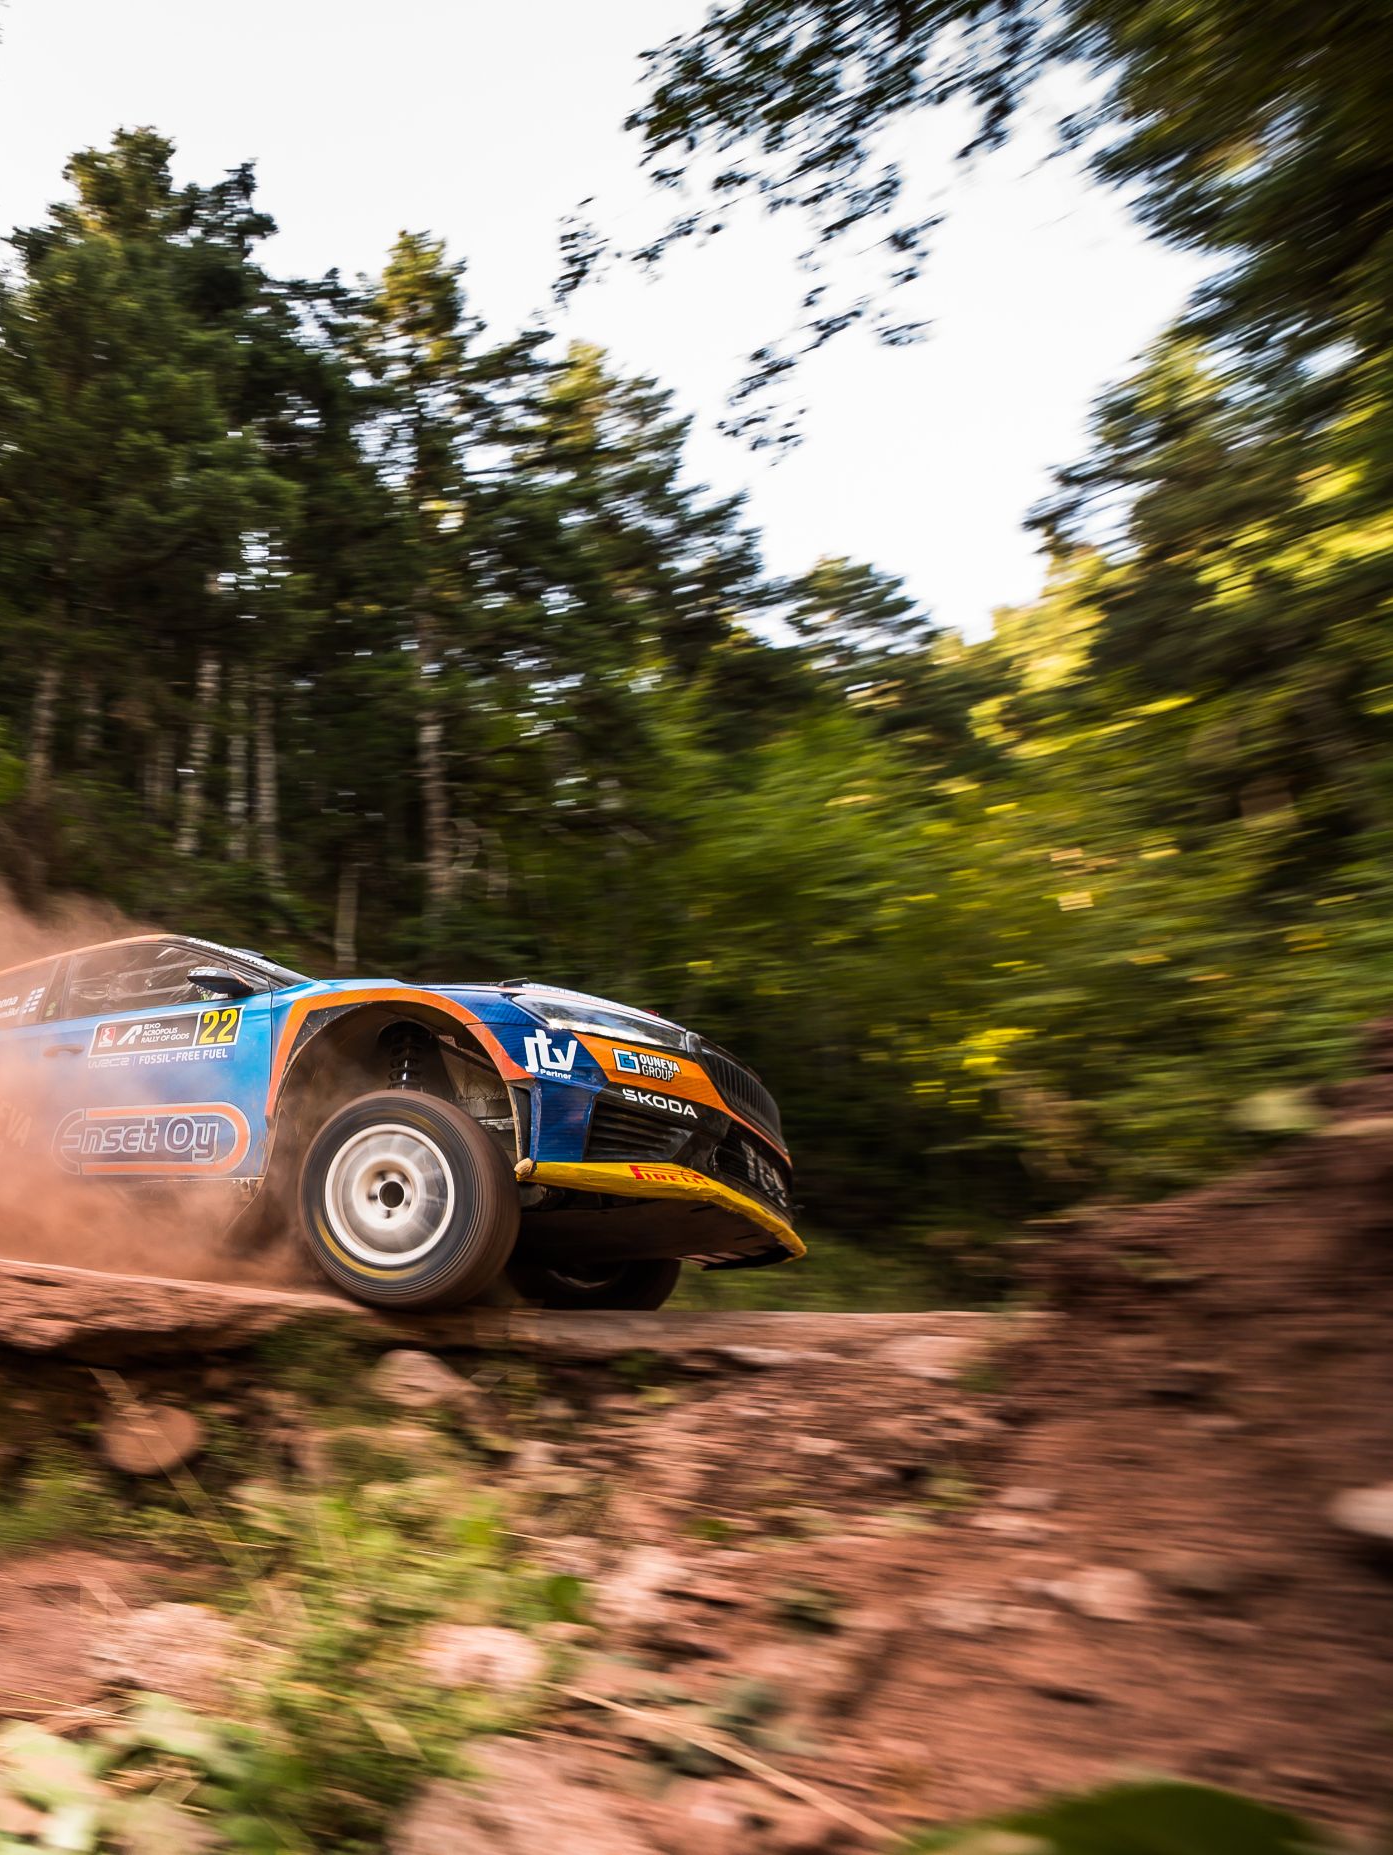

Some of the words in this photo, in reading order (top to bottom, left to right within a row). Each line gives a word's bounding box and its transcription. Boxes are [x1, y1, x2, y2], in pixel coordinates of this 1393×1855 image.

[142, 1027, 178, 1037] ACROPOLIS
[199, 1008, 238, 1045] 22
[141, 1036, 159, 1044] RALLY
[171, 1032, 190, 1041] GODS
[138, 1051, 200, 1065] FOSSIL-FREE
[203, 1048, 228, 1060] FUEL
[540, 1068, 573, 1081] Partner
[641, 1064, 674, 1082] GROUP
[51, 1108, 160, 1176] Enset
[164, 1115, 220, 1163] Oy
